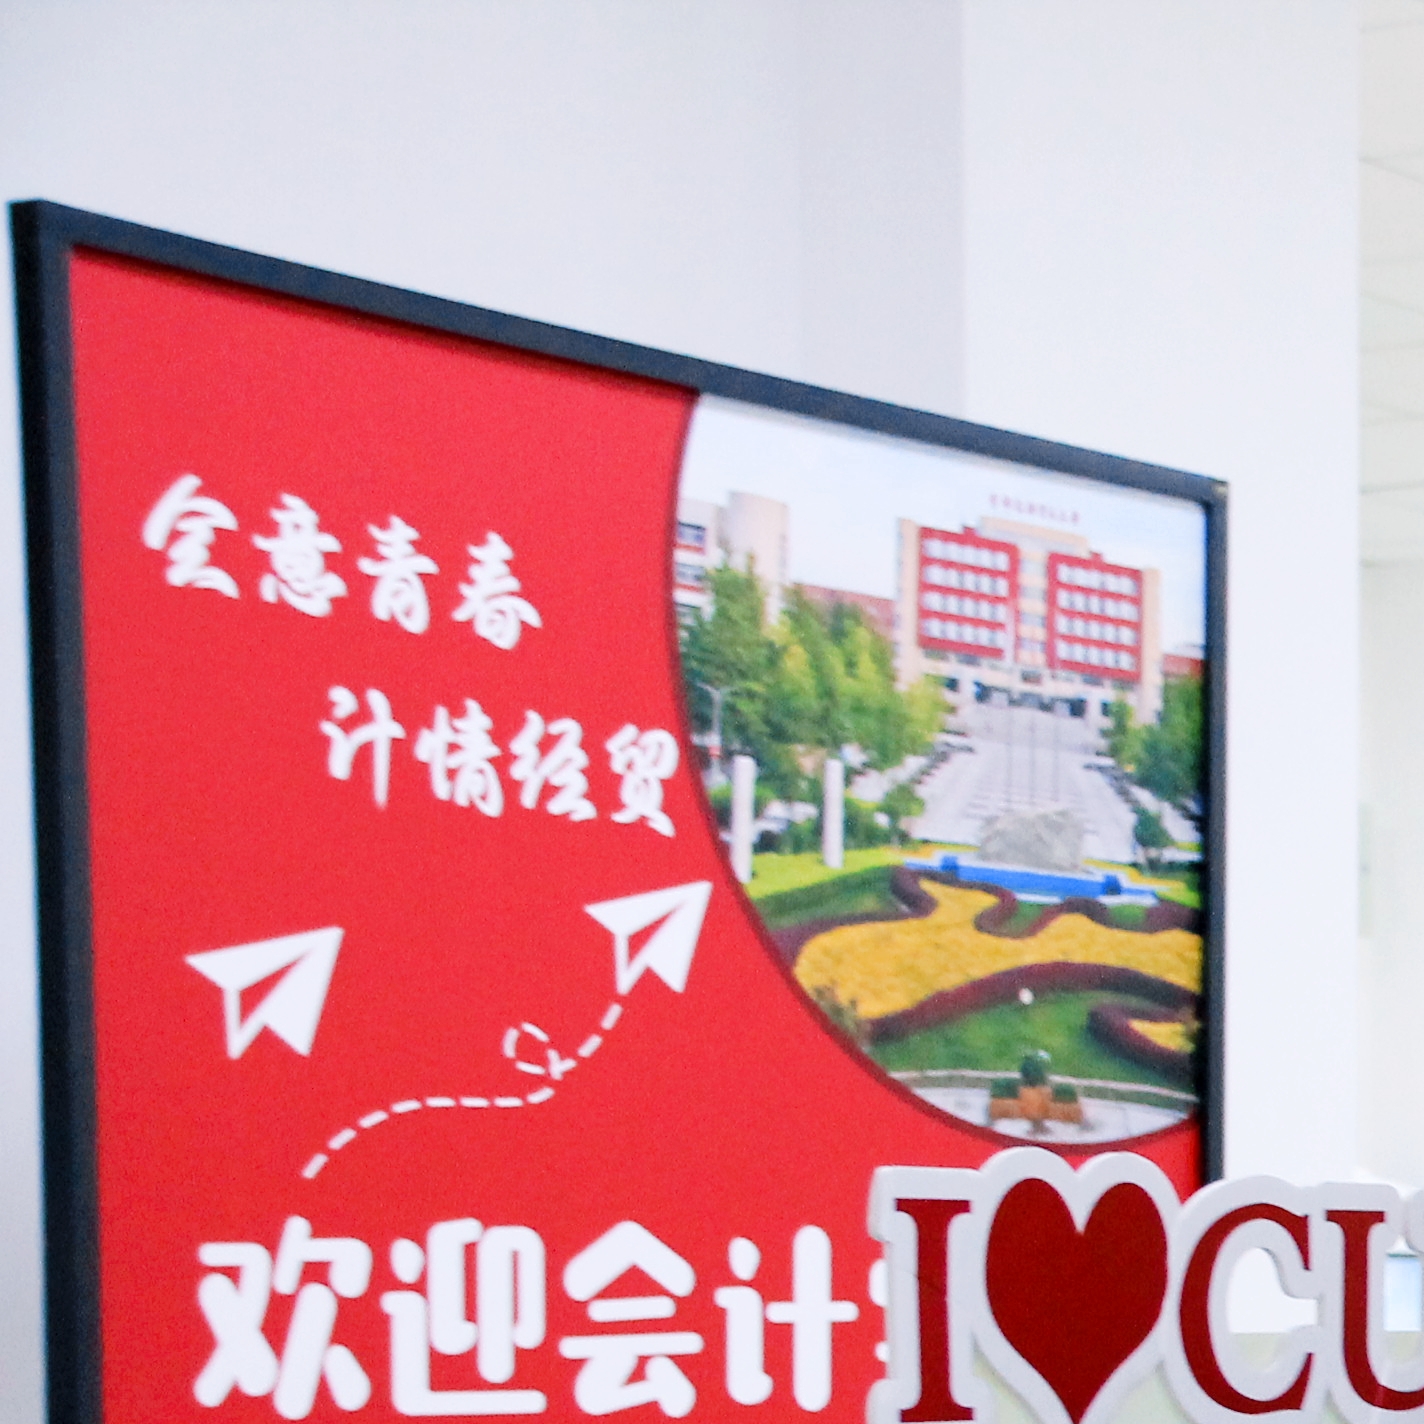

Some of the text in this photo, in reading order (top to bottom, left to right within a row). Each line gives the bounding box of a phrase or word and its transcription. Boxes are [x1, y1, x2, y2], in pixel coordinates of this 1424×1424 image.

[319, 684, 680, 838] 计情经贸
[193, 1215, 888, 1420] 欢迎会计
[893, 1198, 973, 1423] I
